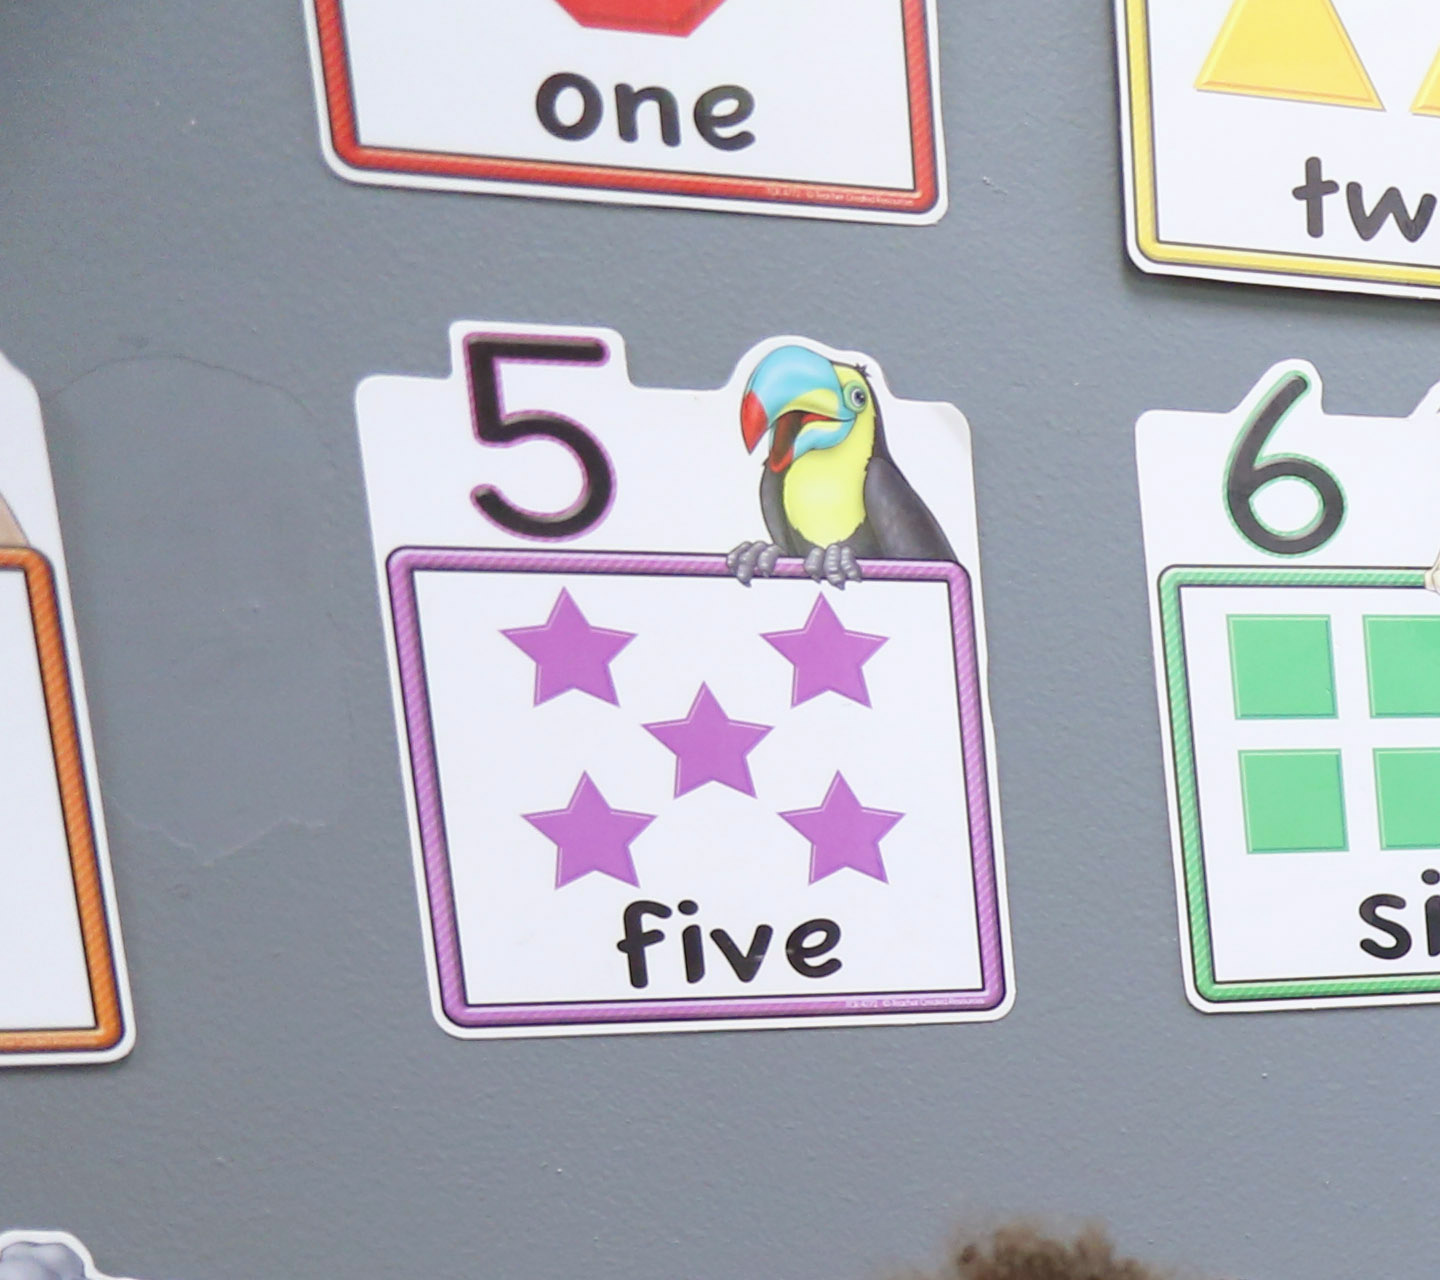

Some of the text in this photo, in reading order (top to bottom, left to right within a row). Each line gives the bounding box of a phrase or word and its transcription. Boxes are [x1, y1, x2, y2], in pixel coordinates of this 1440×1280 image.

[535, 71, 756, 152] one
[462, 331, 616, 542] 5
[1225, 370, 1347, 557] 6
[616, 900, 844, 989] five
